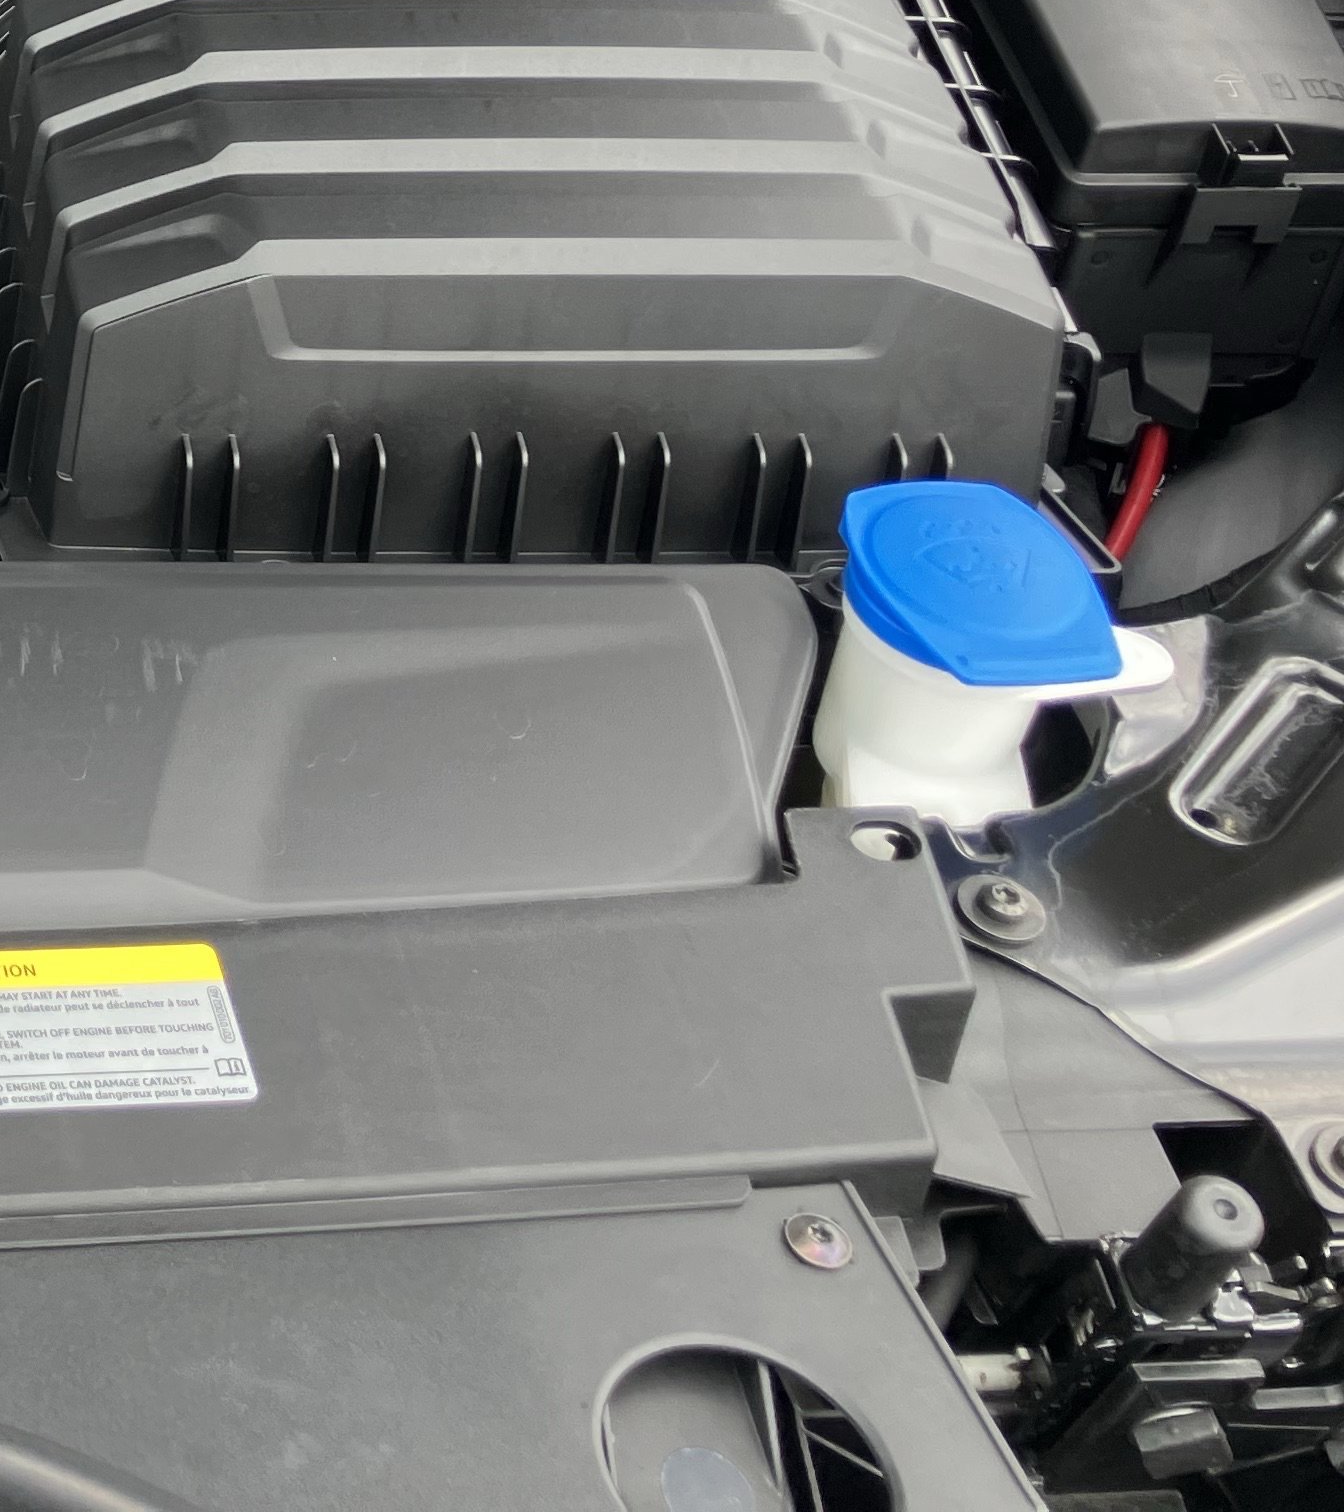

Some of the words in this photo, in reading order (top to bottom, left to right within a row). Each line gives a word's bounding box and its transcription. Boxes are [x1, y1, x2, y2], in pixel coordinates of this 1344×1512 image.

[22, 991, 53, 1000] START
[70, 989, 91, 999] ANY
[95, 989, 121, 997] TIME.
[13, 1003, 62, 1013] radiateur
[64, 1003, 90, 1014] peut
[107, 999, 165, 1009] déclencher
[176, 998, 200, 1007] tout
[7, 1029, 48, 1038] SWITCH
[50, 1028, 70, 1037] OFF
[72, 1027, 112, 1038] ENGINE
[115, 1025, 156, 1035] BEFORE
[159, 1023, 214, 1033] TOUCHING
[13, 1051, 50, 1061] arrêter
[53, 1052, 63, 1060] le
[66, 1050, 105, 1060] moteur
[108, 1049, 139, 1058] avant
[142, 1047, 155, 1056] de
[158, 1046, 199, 1056] toucher
[202, 1045, 209, 1054] à
[6, 1082, 47, 1092] ENGINE
[49, 1081, 66, 1090] OIL
[69, 1080, 92, 1089] CAN
[95, 1078, 140, 1087] DAMAGE
[143, 1076, 196, 1086] CATALYST.
[11, 1093, 53, 1103] excessif
[56, 1091, 93, 1101] d'huile
[95, 1090, 152, 1100] dangereux
[155, 1089, 179, 1099] pour
[182, 1088, 192, 1096] le
[195, 1086, 249, 1096] catalyseur
